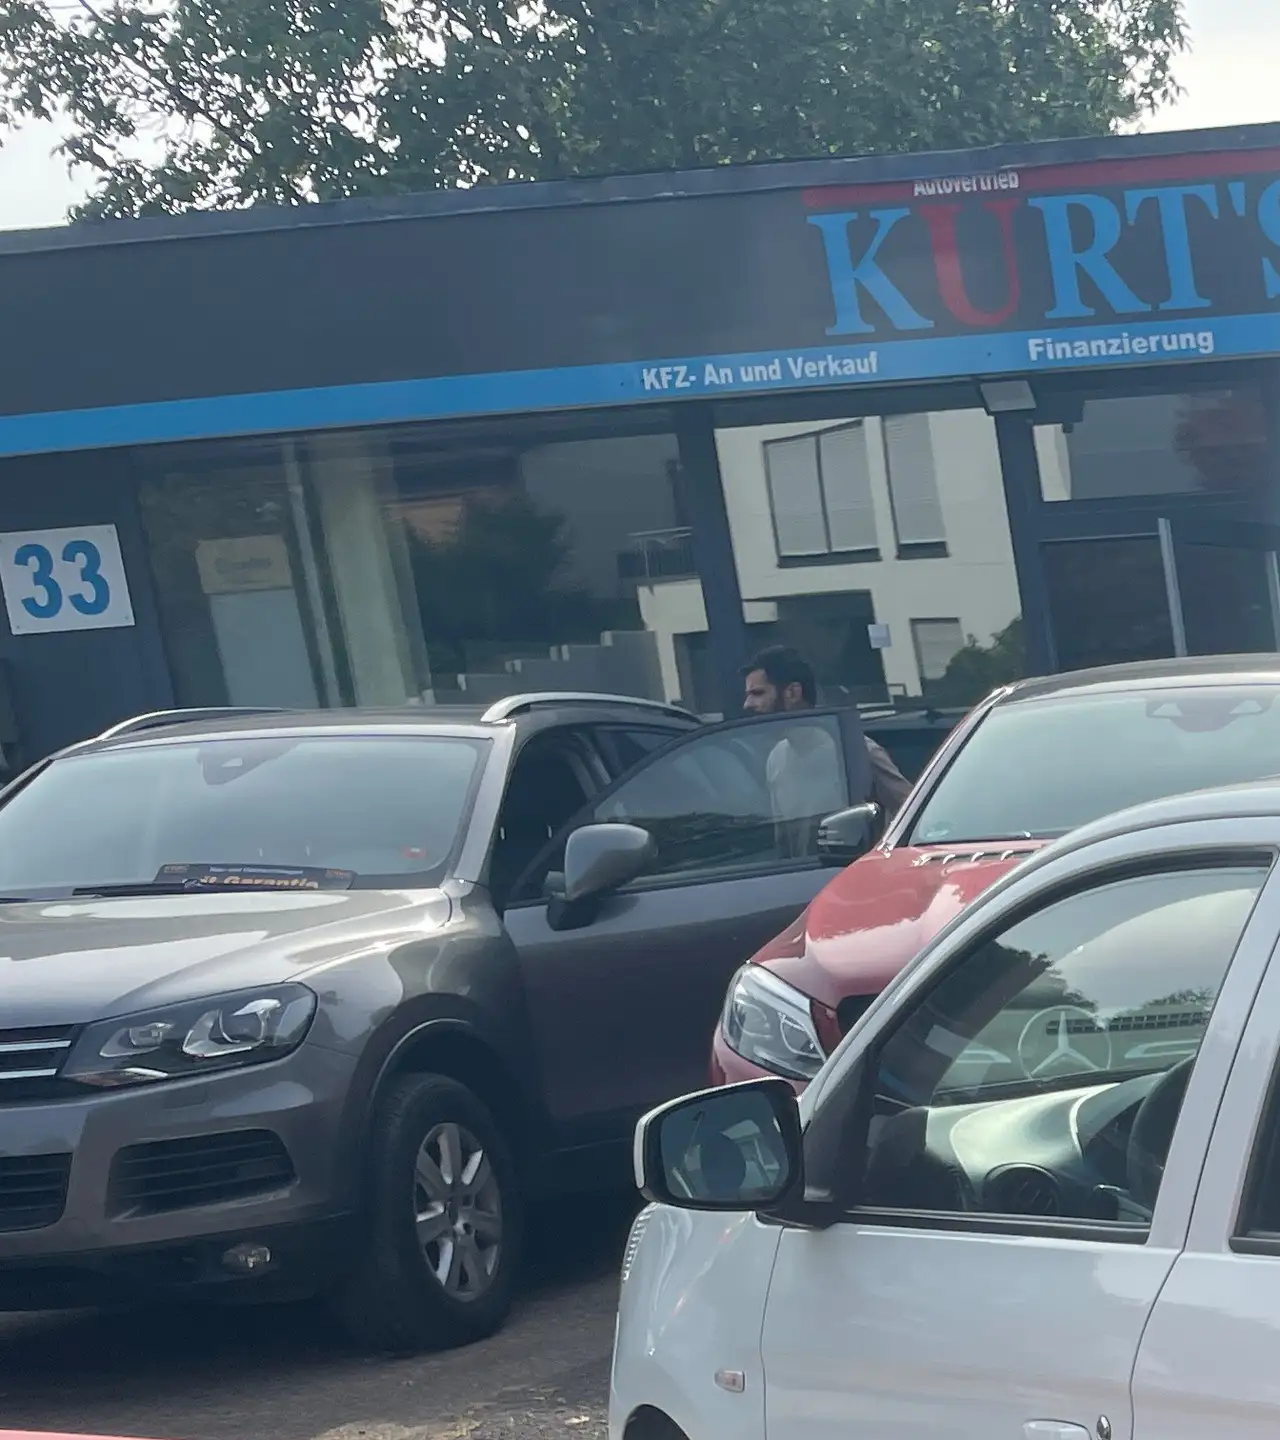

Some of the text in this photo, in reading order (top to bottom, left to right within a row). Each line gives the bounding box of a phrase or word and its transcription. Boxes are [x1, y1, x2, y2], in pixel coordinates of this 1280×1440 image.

[1028, 327, 1215, 363] Finanzierung
[642, 351, 879, 391] KFZ- An und Verkauf
[13, 540, 112, 620] 33
